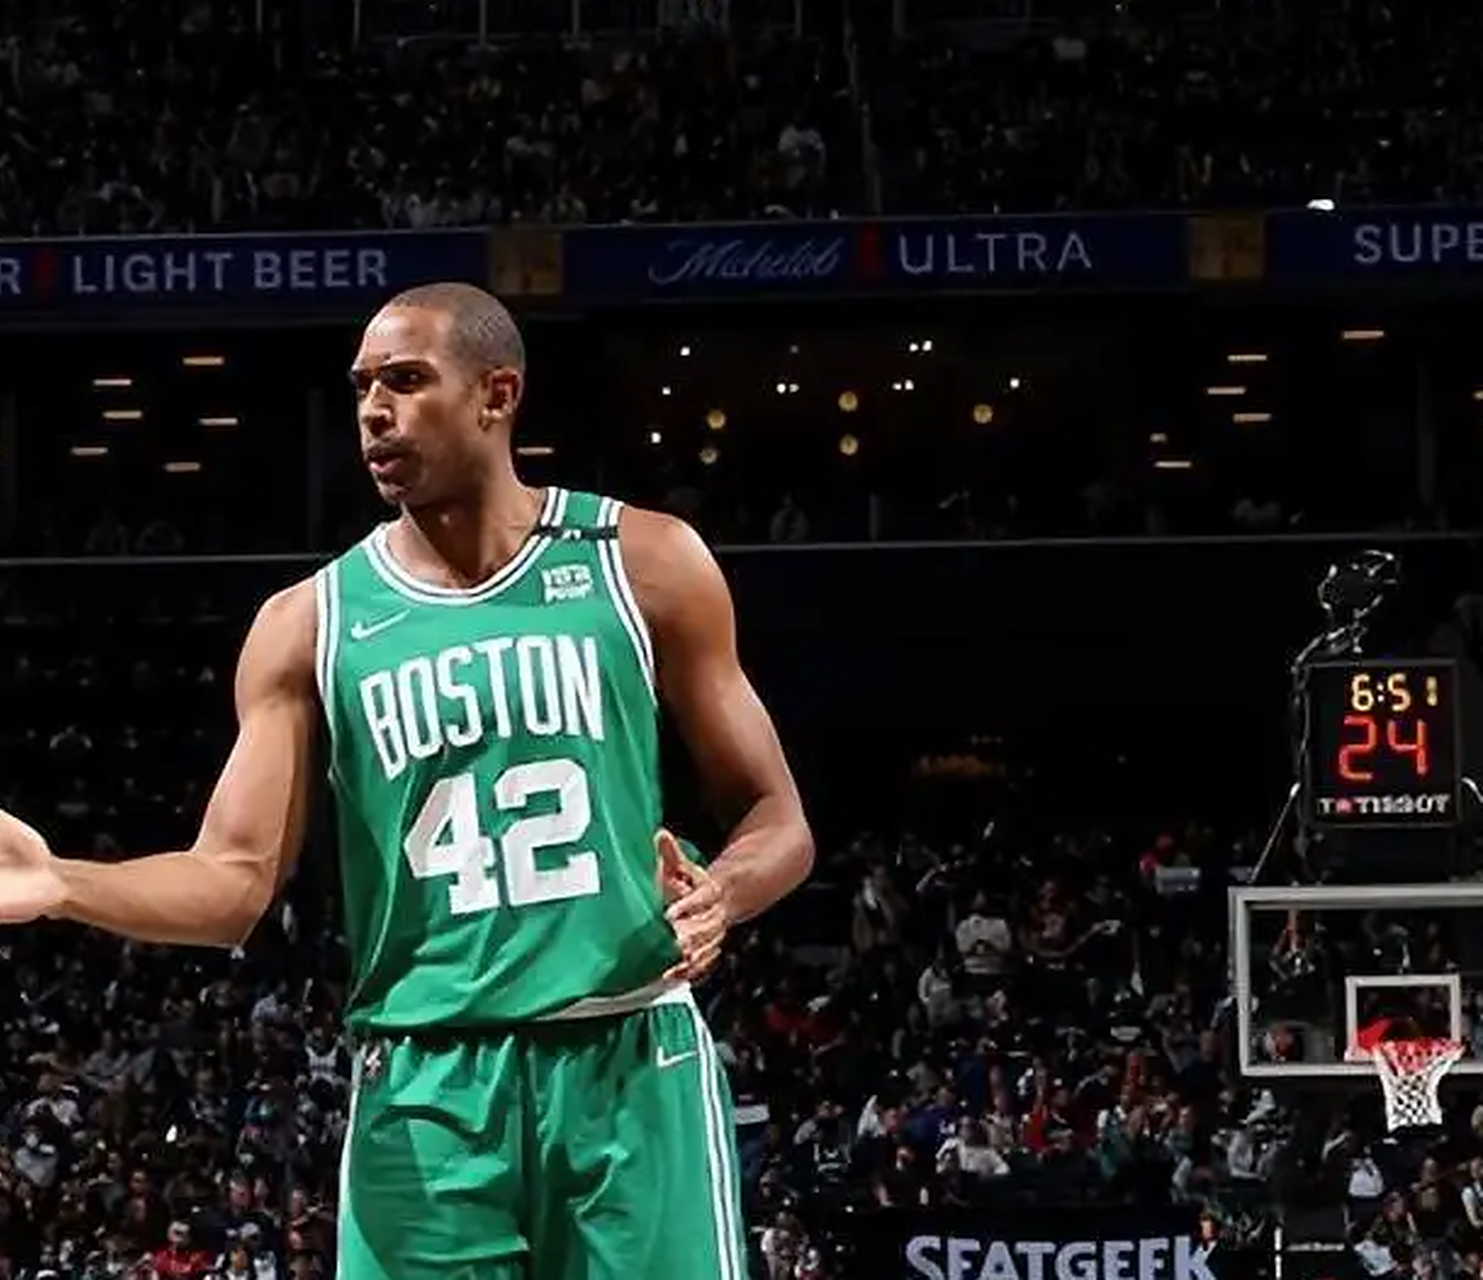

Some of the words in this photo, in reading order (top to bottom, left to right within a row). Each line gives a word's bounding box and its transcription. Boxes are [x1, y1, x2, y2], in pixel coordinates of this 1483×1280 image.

[72, 251, 235, 294] LIGHT
[253, 248, 389, 291] BEER
[897, 230, 1093, 276] ULTRA
[359, 634, 605, 781] BOSTON
[1350, 673, 1438, 712] 6:51
[1337, 713, 1429, 782] 24
[403, 758, 601, 915] 42
